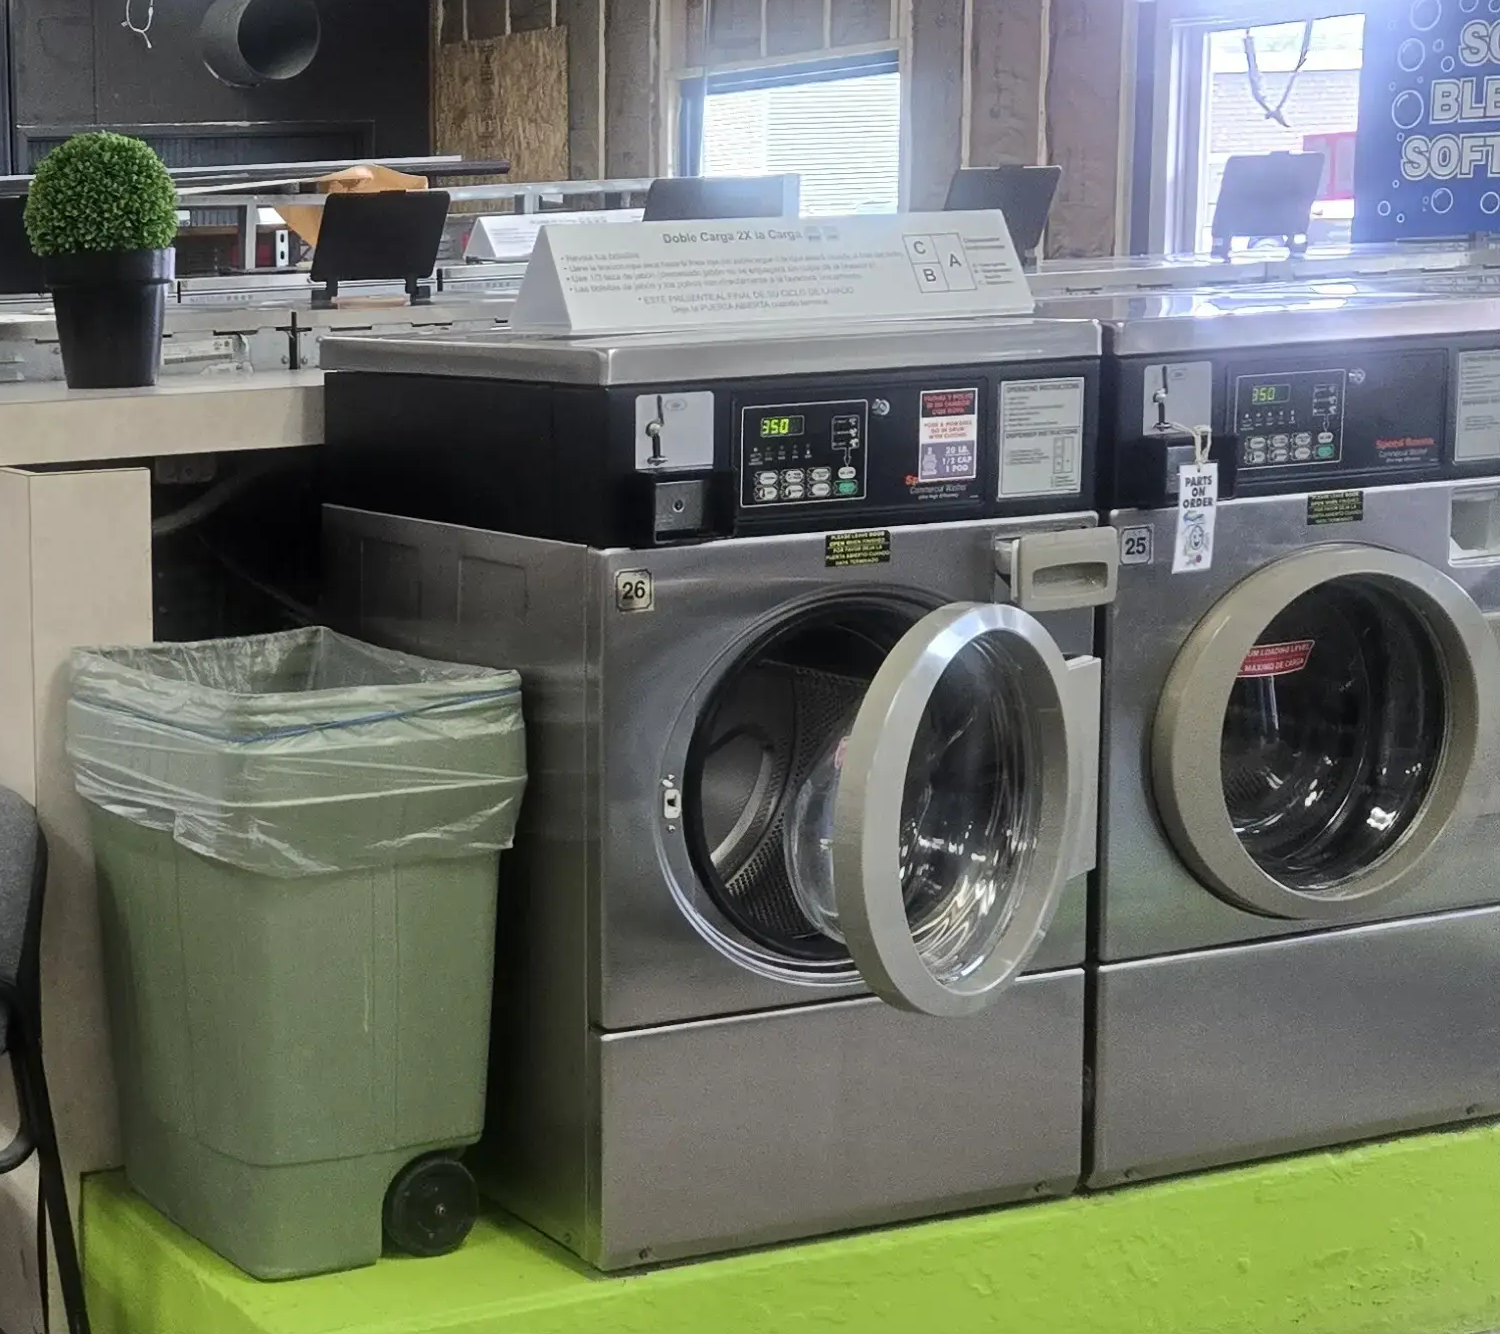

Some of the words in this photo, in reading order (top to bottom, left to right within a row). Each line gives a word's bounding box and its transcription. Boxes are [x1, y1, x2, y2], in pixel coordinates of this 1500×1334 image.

[663, 233, 697, 244] Doble
[700, 232, 735, 243] Carga
[738, 230, 752, 241] 2X
[768, 229, 802, 240] Carga
[913, 241, 926, 255] C
[950, 254, 962, 267] A
[923, 268, 936, 282] B
[1253, 386, 1276, 402] 350
[761, 419, 789, 435] 350
[946, 446, 956, 455] 20
[942, 457, 956, 465] 1/2
[952, 464, 969, 473] POD
[1185, 476, 1212, 487] PARTS
[1191, 487, 1206, 497] ON
[1183, 497, 1214, 509] ORDER
[1125, 537, 1146, 555] 25
[622, 580, 646, 599] 26
